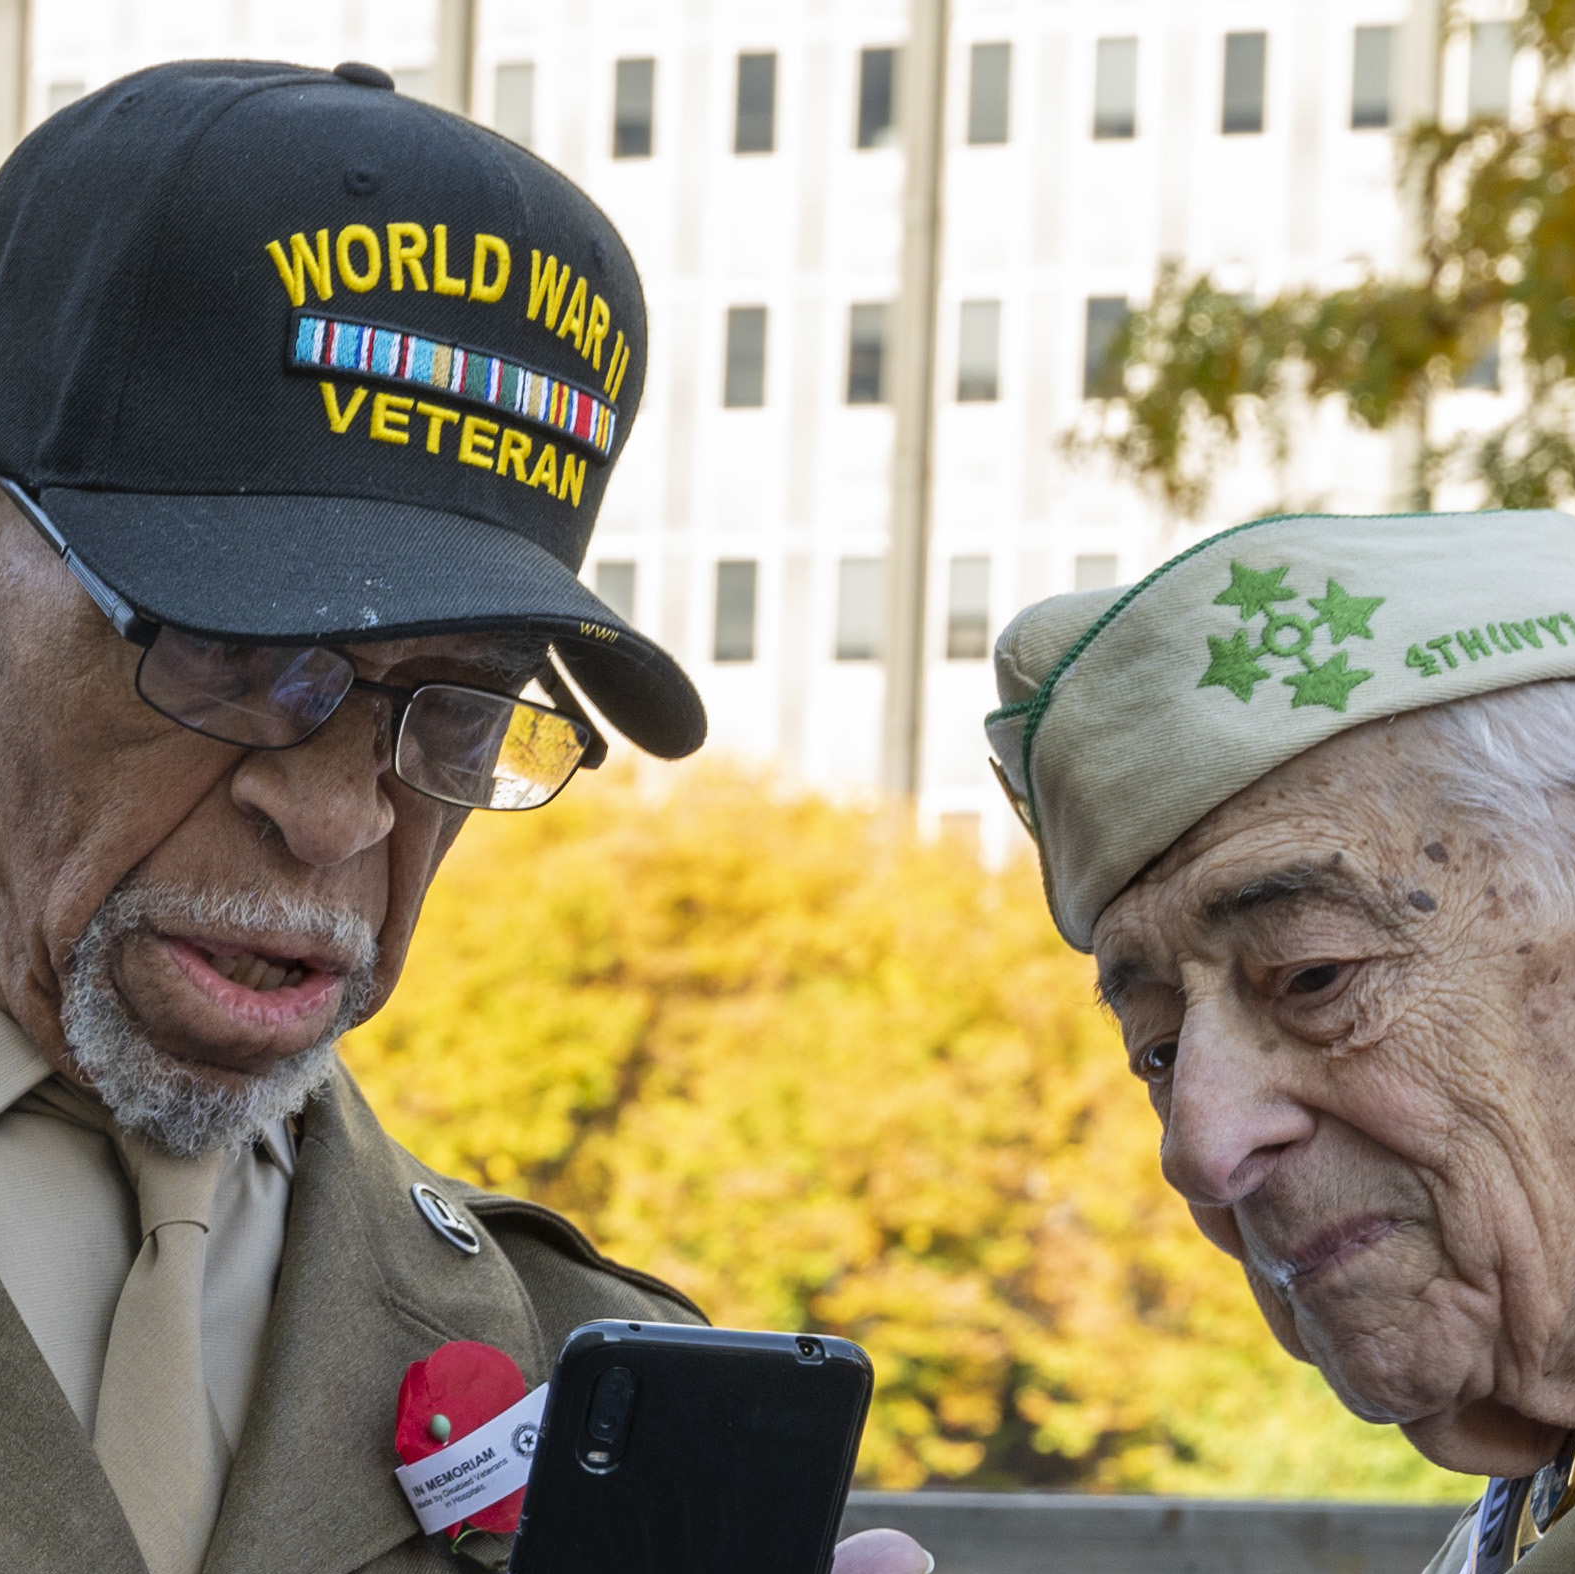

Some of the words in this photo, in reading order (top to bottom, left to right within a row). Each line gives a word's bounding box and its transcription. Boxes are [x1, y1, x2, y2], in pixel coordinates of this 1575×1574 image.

[265, 221, 511, 307] WORLD
[526, 248, 612, 371] WAR
[604, 330, 630, 401] II
[321, 381, 587, 508] VETERAN
[579, 621, 619, 643] WWII
[412, 1484, 425, 1498] IN
[425, 1447, 496, 1493] MEMORIAM
[433, 1493, 443, 1504] by
[474, 1458, 509, 1480] Veterans
[452, 1484, 486, 1506] Hospitals
